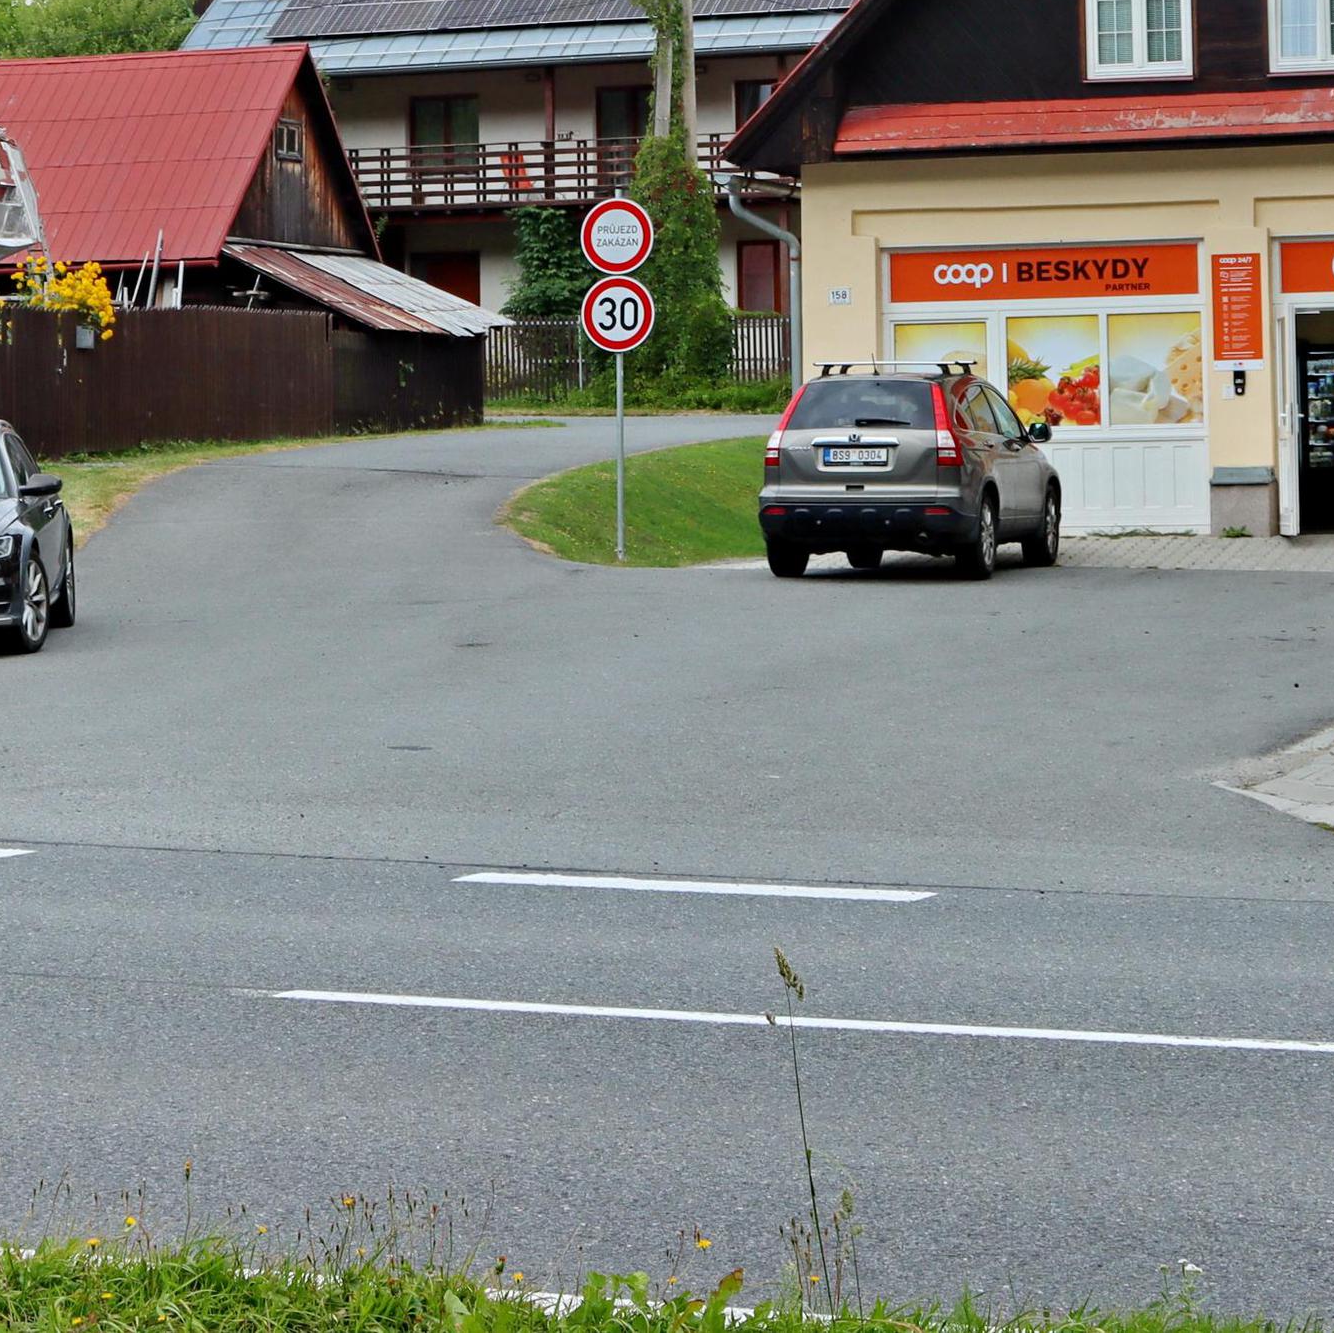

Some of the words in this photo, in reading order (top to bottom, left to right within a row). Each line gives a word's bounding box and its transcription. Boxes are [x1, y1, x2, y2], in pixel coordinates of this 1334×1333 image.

[597, 223, 638, 235] PRŮJEZD
[596, 236, 639, 248] ZAKÁZÁN
[933, 262, 994, 288] coop
[1017, 257, 1150, 282] BESKYDY
[1104, 282, 1151, 292] PARTNER
[831, 290, 847, 300] 158
[598, 297, 639, 331] 30
[832, 449, 851, 460] 8S9
[858, 449, 882, 460] 0304
